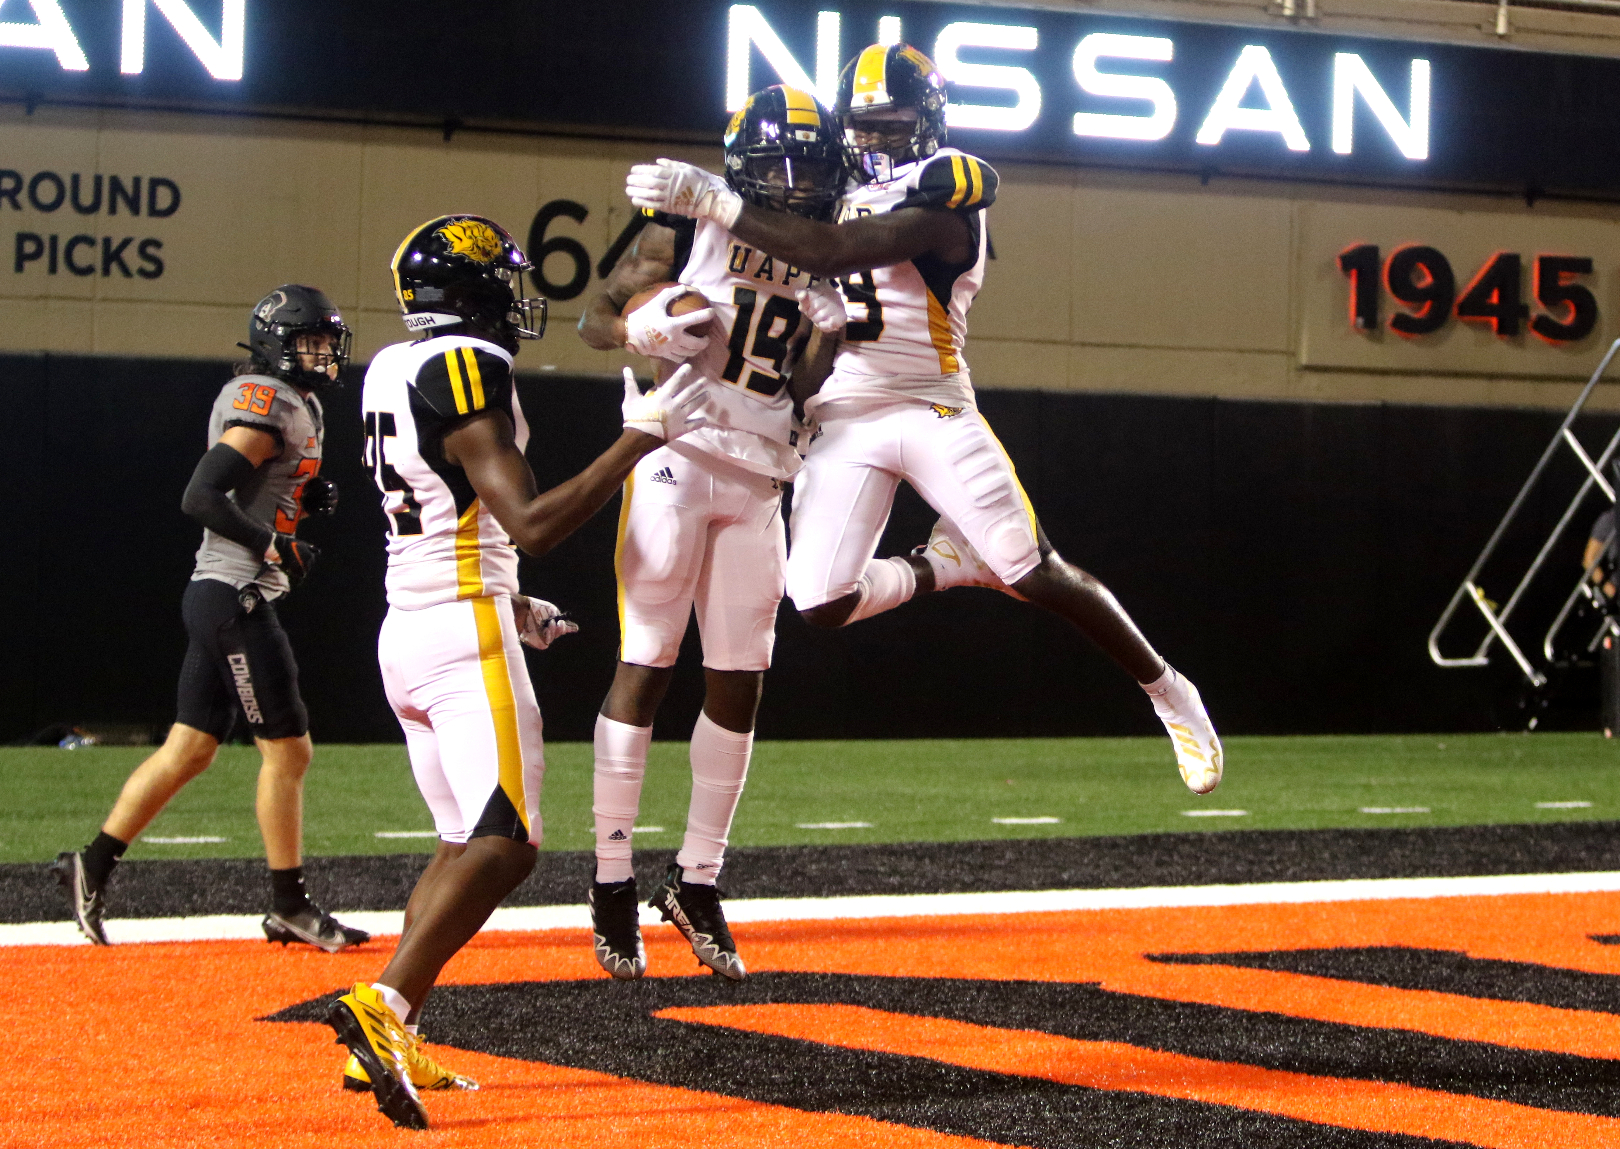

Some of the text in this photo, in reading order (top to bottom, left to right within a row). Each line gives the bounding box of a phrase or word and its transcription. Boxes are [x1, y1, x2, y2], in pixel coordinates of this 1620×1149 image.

[0, 169, 181, 218] ROUND
[14, 231, 165, 280] PICKS
[402, 289, 414, 301] 85
[1337, 243, 1598, 345] 1945
[722, 286, 801, 397] 19
[232, 382, 277, 416] 39
[274, 456, 322, 535] 3
[226, 653, 264, 724] COWBOYS
